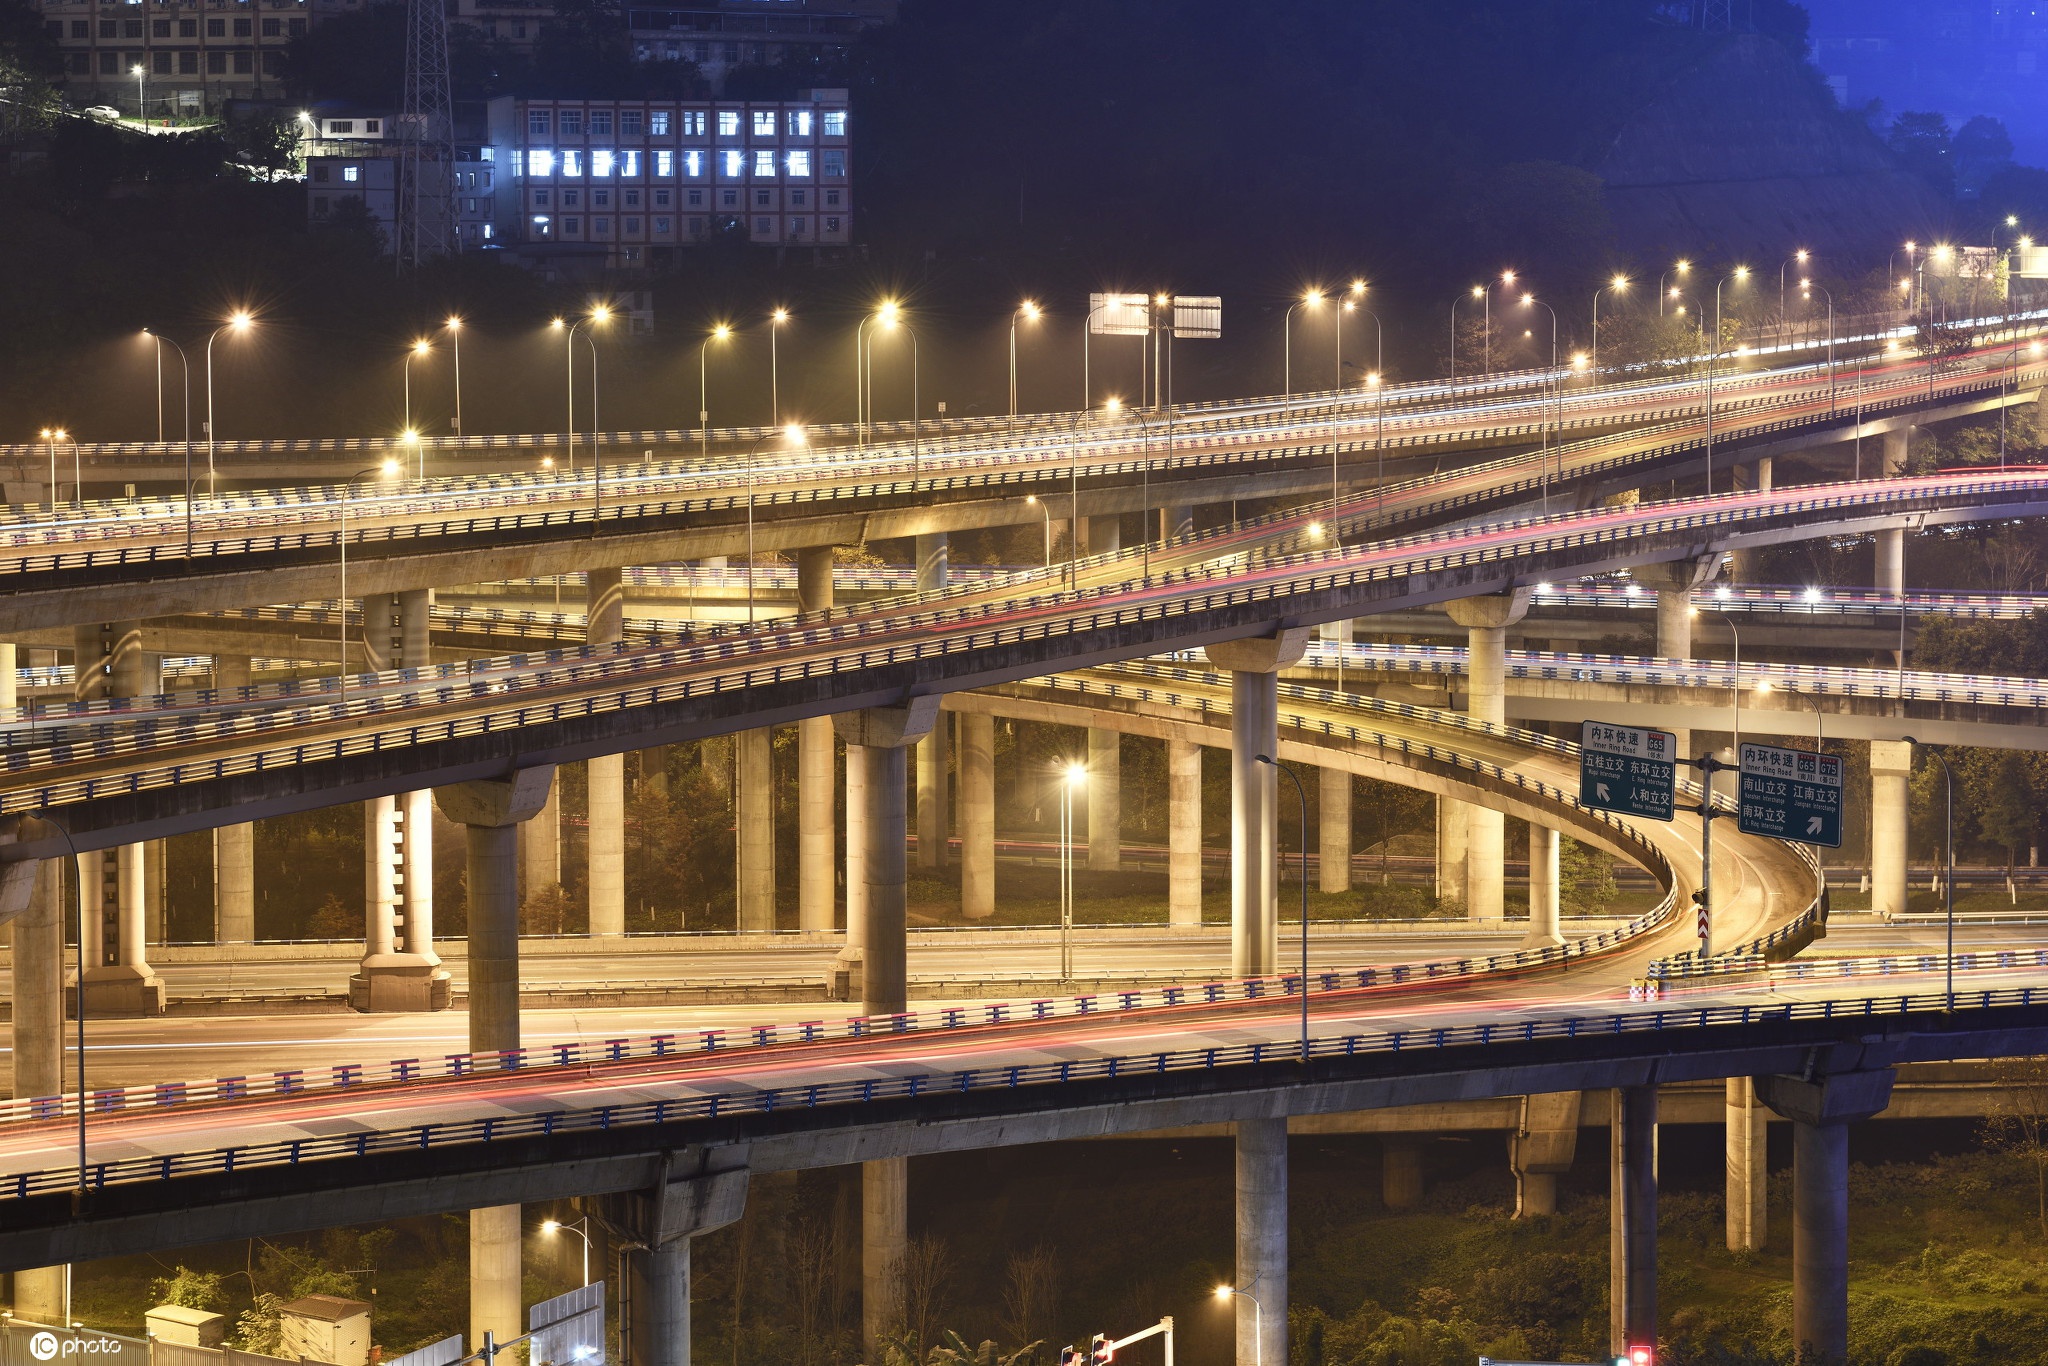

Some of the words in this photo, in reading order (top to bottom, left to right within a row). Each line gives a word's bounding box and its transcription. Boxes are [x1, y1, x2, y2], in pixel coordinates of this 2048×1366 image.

[1591, 726, 1639, 746] 内环快速
[1648, 739, 1663, 750] G65
[1593, 741, 1607, 750] Inner
[1608, 743, 1621, 753] Ring
[1622, 745, 1636, 754] Road
[1585, 753, 1625, 772] 五桂立交
[1745, 748, 1794, 768] 内环快速
[1798, 760, 1815, 771] G65
[1630, 761, 1671, 780] 东环立交
[1745, 763, 1761, 772] Inner
[1762, 765, 1776, 775] Ring
[1777, 767, 1792, 777] Road
[1821, 763, 1837, 774] G75
[1629, 786, 1670, 806] 人和立交
[1743, 777, 1787, 796] 南山立交
[1793, 784, 1838, 804] 江南立交
[1743, 803, 1786, 824] 南环立交
